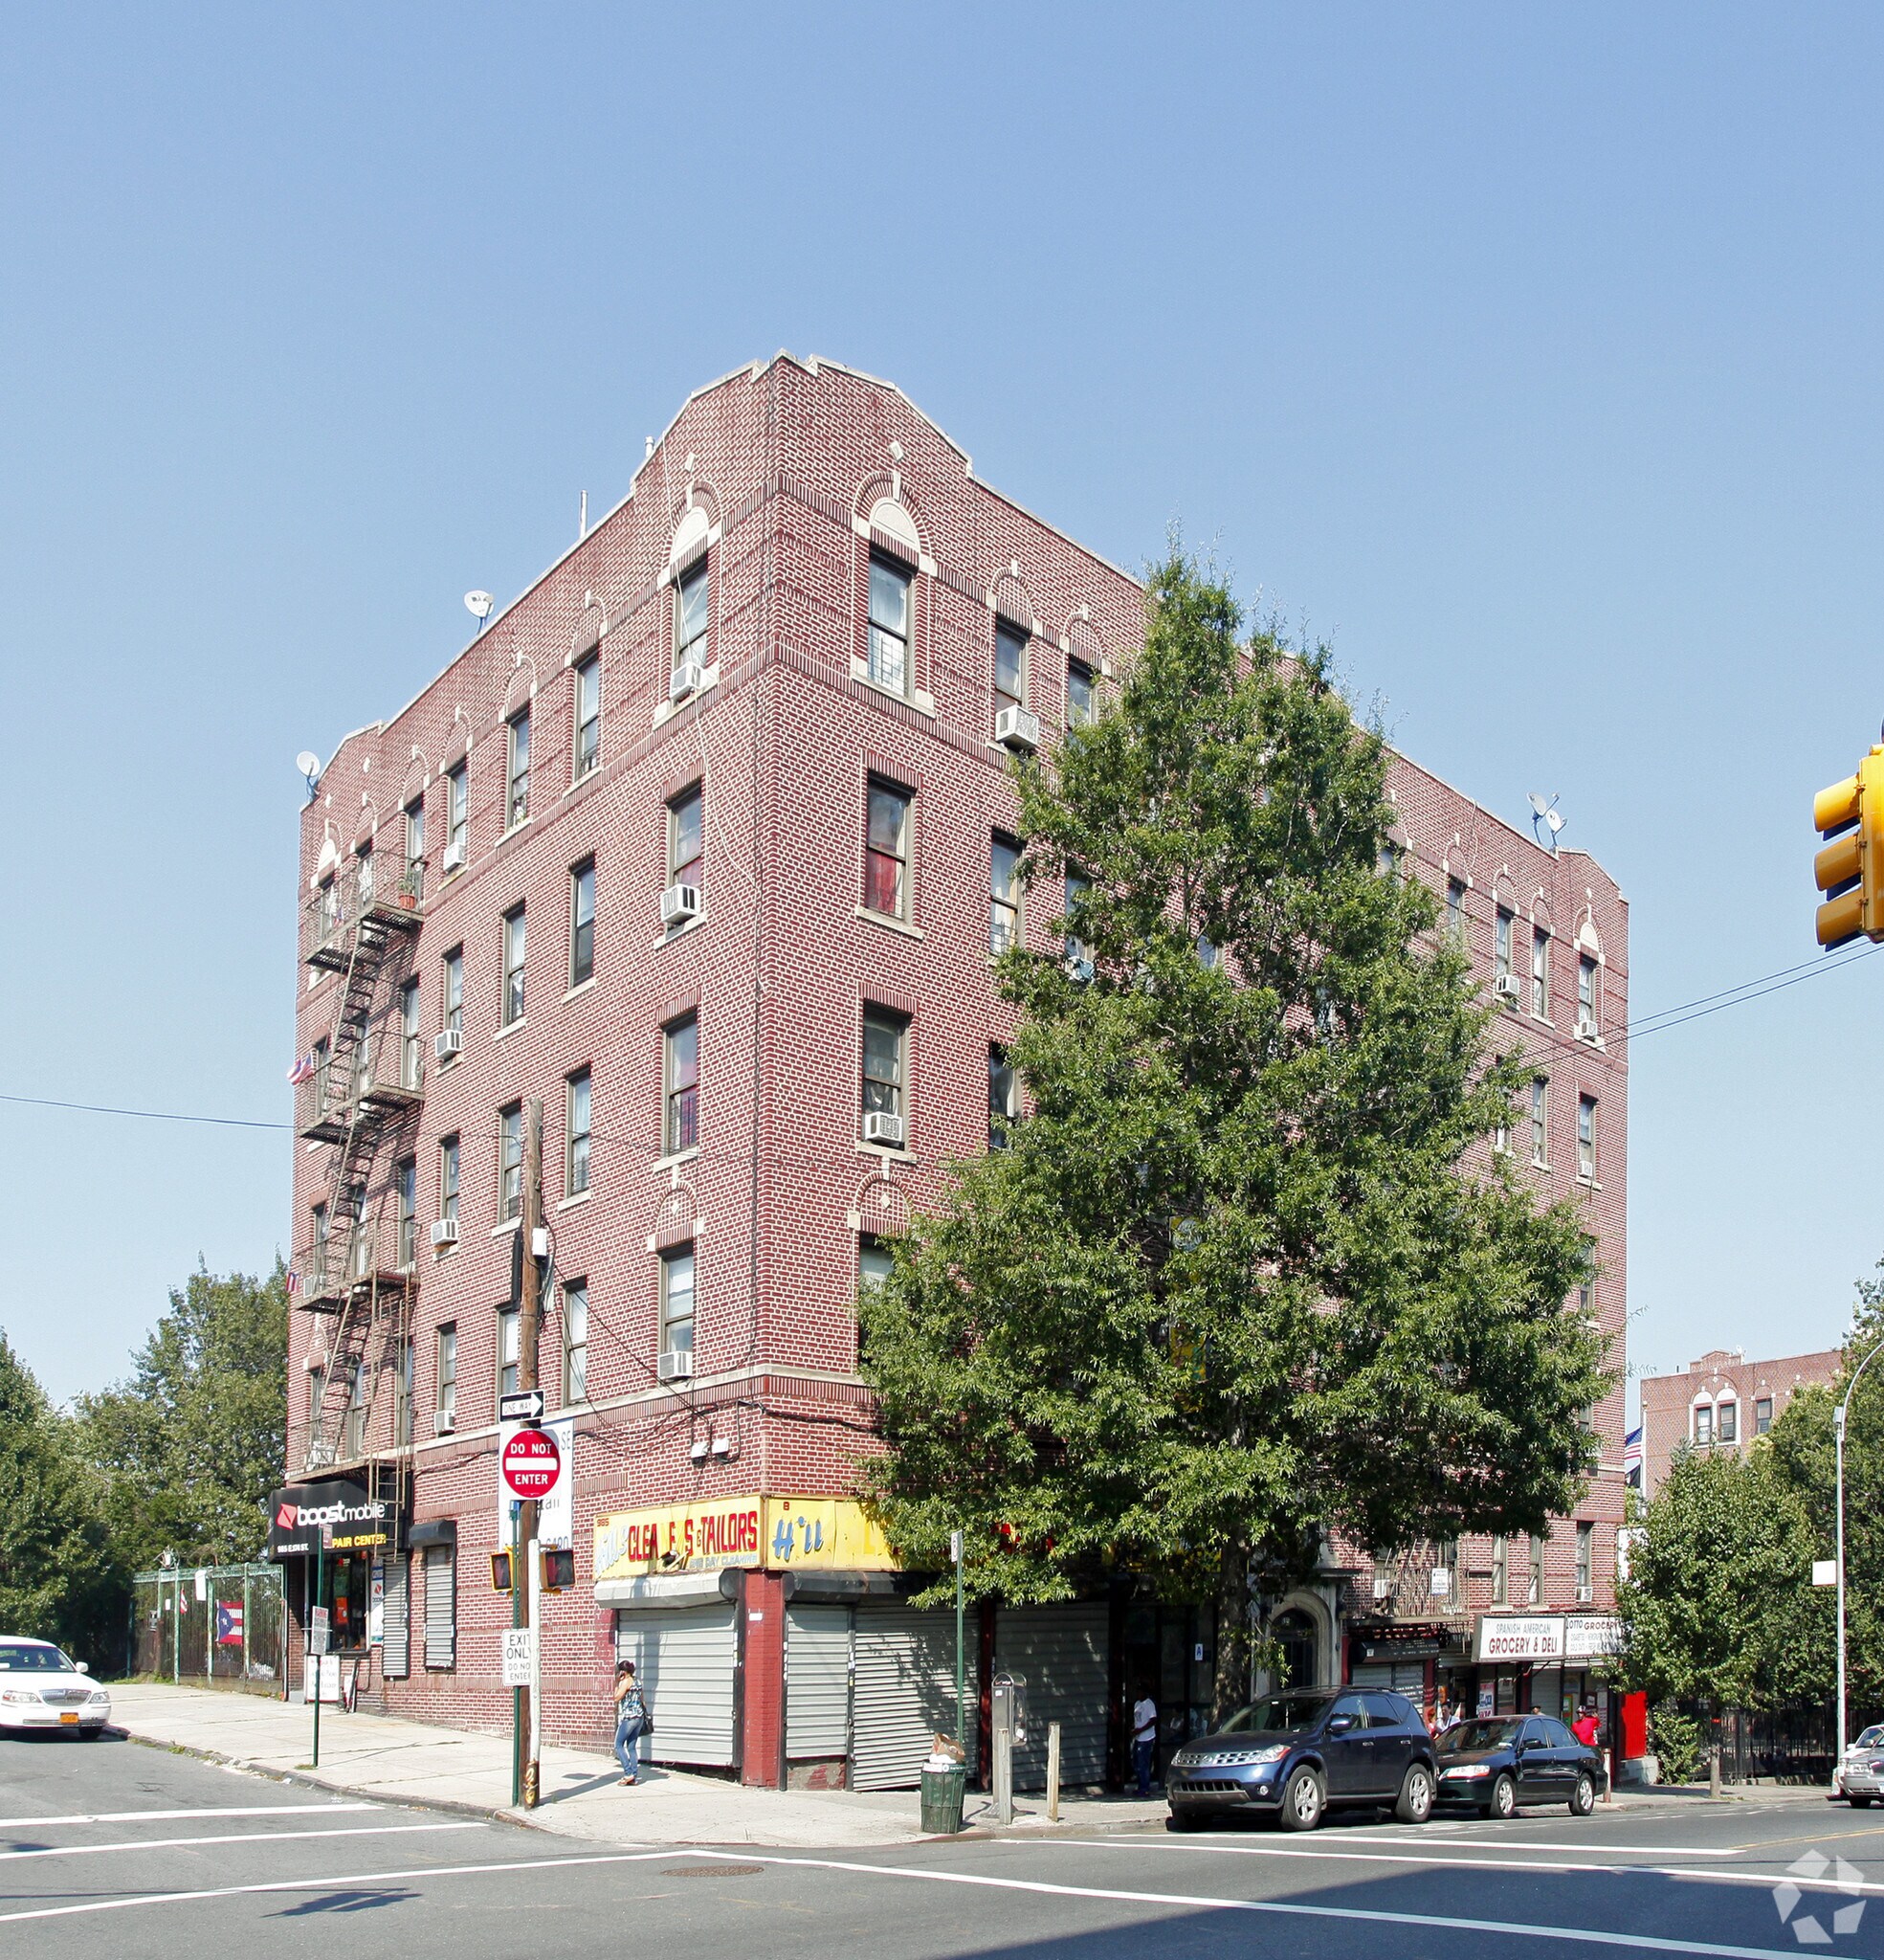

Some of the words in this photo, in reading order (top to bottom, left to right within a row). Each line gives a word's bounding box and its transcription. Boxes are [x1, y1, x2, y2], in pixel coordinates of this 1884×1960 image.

[503, 1403, 516, 1414] ONE
[519, 1401, 532, 1412] WAY
[510, 1443, 525, 1455] DO
[531, 1442, 552, 1455] NOT
[515, 1473, 548, 1485] ENTER
[596, 1517, 610, 1527] 985
[354, 1533, 387, 1548] CENTER
[628, 1519, 694, 1563] CLEAES
[700, 1510, 759, 1556] TAILORS
[1496, 1623, 1521, 1635] SPANISH
[1489, 1637, 1531, 1655] GROCERY
[1533, 1637, 1539, 1653] &
[1541, 1637, 1558, 1653] DELI
[508, 1662, 519, 1671] DO
[520, 1661, 531, 1671] NO
